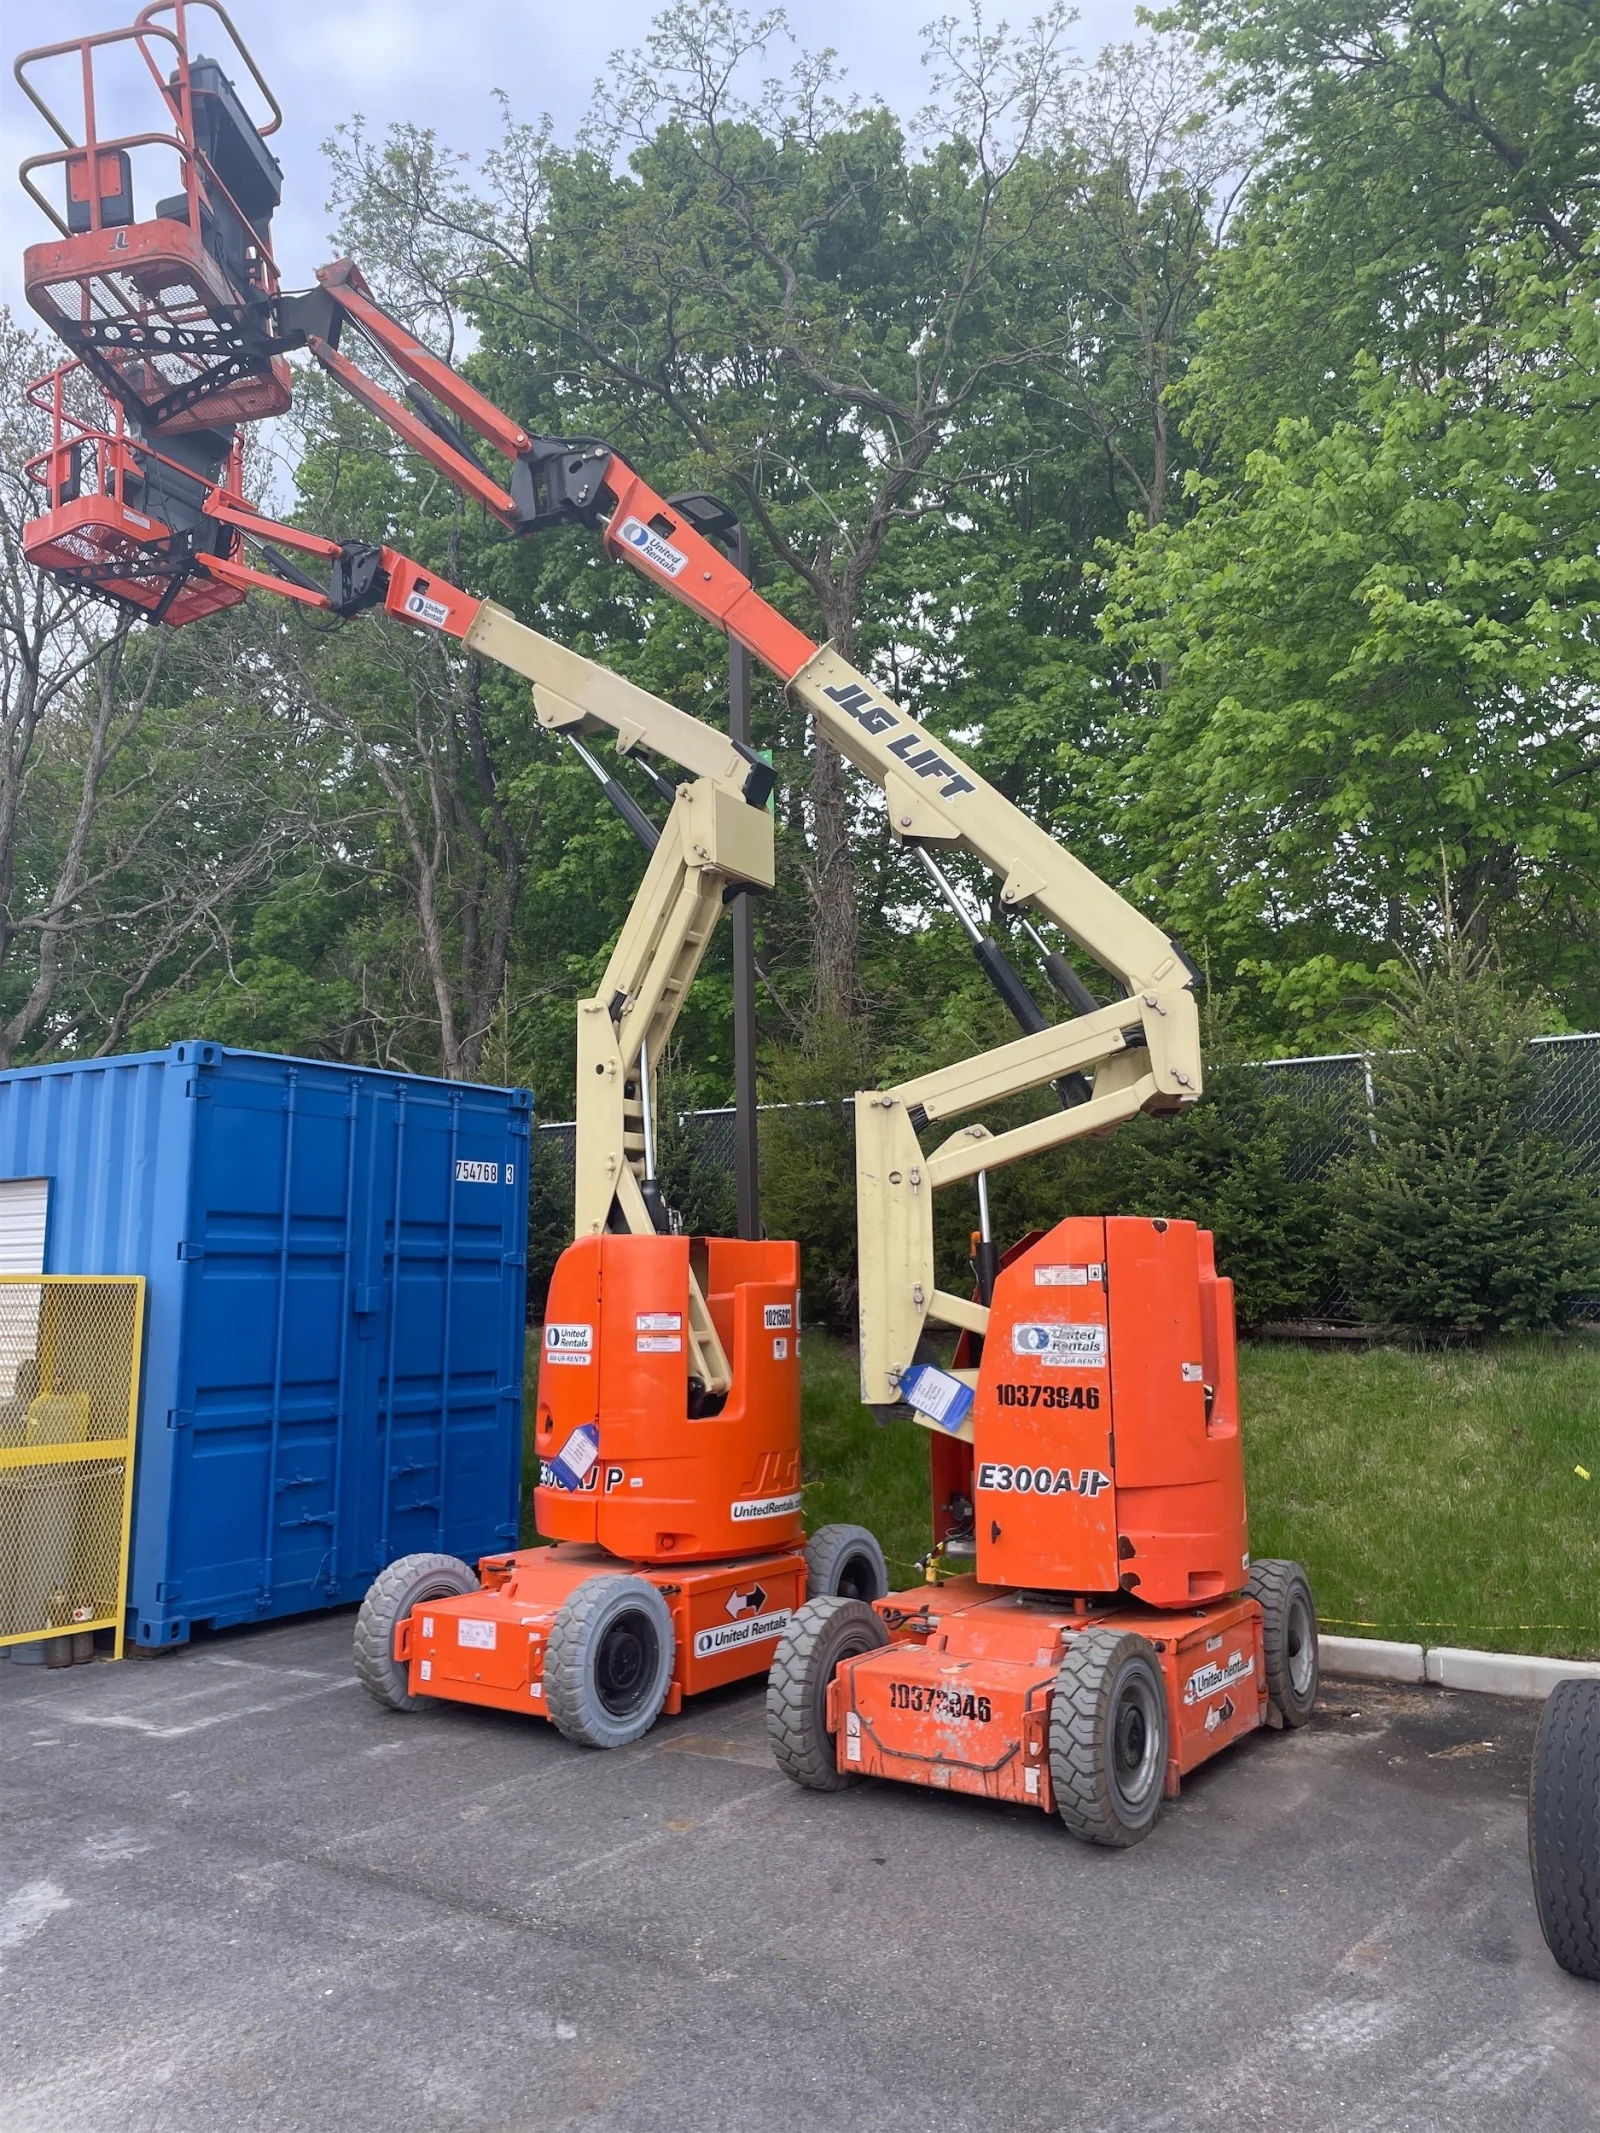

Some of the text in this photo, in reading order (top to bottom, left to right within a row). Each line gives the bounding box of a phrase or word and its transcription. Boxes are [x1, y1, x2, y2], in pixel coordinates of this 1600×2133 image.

[643, 545, 677, 573] Rentals
[650, 538, 682, 564] United
[421, 609, 443, 624] Rentals
[425, 602, 446, 616] United
[822, 683, 978, 798] JLG LIFT
[455, 1162, 513, 1183] 754768 3
[560, 1338, 588, 1347] Rentals
[561, 1328, 587, 1338] United
[996, 1384, 1100, 1410] 10373946
[979, 1464, 1110, 1496] E300AJP
[715, 1616, 787, 1647] United Rentals
